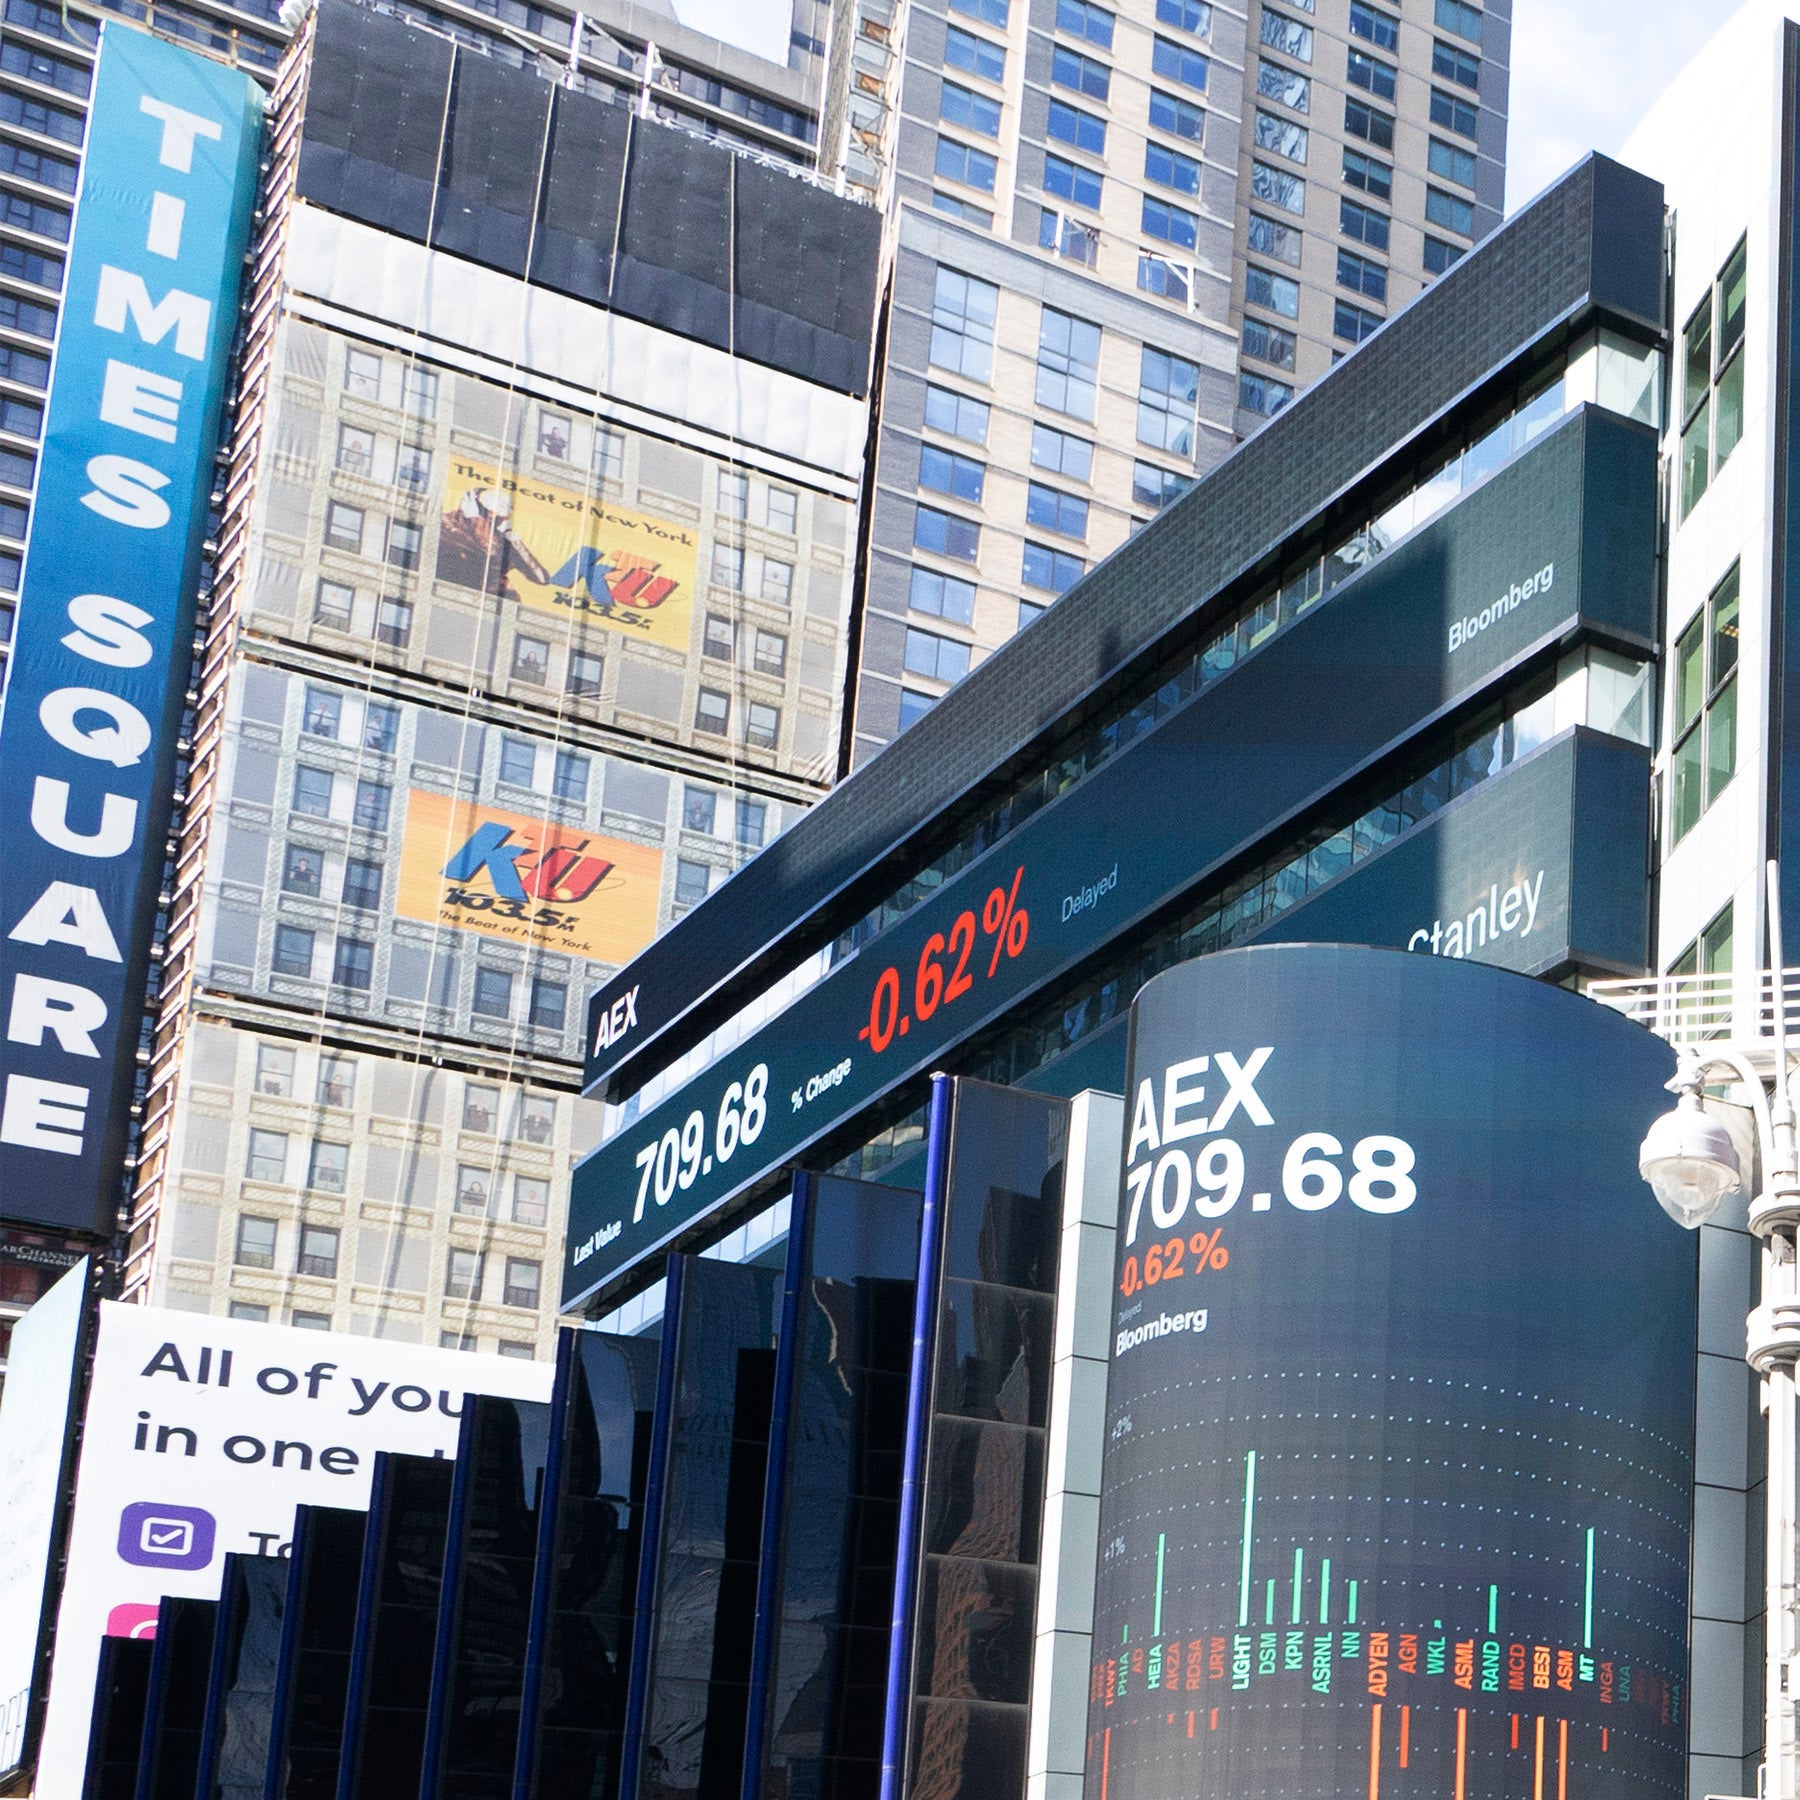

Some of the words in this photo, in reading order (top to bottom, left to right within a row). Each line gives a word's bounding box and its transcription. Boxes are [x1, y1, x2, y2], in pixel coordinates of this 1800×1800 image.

[93, 95, 222, 530] TIMES
[453, 462, 495, 486] The
[501, 478, 555, 505] Beat
[561, 497, 584, 513] of
[589, 504, 638, 530] New
[642, 521, 693, 547] York
[548, 546, 680, 609] KTU
[1447, 561, 1555, 655] Bloomberg
[5, 593, 154, 1157] SQUARE
[438, 821, 616, 904] KTU
[443, 887, 568, 928] 103.5
[466, 916, 498, 930] Beat
[502, 924, 519, 935] of
[522, 928, 559, 943] New
[561, 936, 592, 951] York
[857, 866, 1030, 1054] -0.62%
[1061, 862, 1118, 924] Delayed
[593, 985, 640, 1058] AEX
[791, 1090, 804, 1115] %
[806, 1056, 852, 1104] Change
[1127, 1046, 1275, 1167] AEX
[631, 1063, 770, 1226] 709.68
[1125, 1132, 1418, 1247] 709.68
[573, 1236, 597, 1267] Last
[597, 1218, 623, 1254] Value
[1120, 1227, 1229, 1297] -0.62%
[1116, 1308, 1208, 1357] Bloomberg
[141, 1342, 233, 1388] All
[256, 1361, 339, 1399] of
[134, 1410, 198, 1458] in
[223, 1434, 360, 1476] one
[1104, 1535, 1126, 1561] +1%
[1147, 1644, 1162, 1689] HEIA
[1165, 1641, 1180, 1691] AKZA
[1185, 1638, 1202, 1692] RDSA
[1208, 1636, 1226, 1680] URW
[1232, 1633, 1252, 1690] LIGHT
[1258, 1632, 1277, 1675] DSM
[1284, 1631, 1304, 1670] KPN
[1311, 1631, 1333, 1694] ASRNL
[1341, 1631, 1361, 1658] NN
[1368, 1632, 1390, 1697] ADYEN
[1398, 1634, 1418, 1674] AGN
[1426, 1636, 1446, 1675] WKL
[1454, 1638, 1475, 1690] ASML
[1481, 1640, 1500, 1692] RAND
[1508, 1643, 1526, 1691] IMCD
[1532, 1645, 1551, 1689] BESI
[1556, 1649, 1574, 1691] ASM
[1579, 1653, 1595, 1682] MT
[1117, 1652, 1130, 1696] PHIA
[1600, 1661, 1614, 1704] INGA
[1619, 1665, 1631, 1702] UNA
